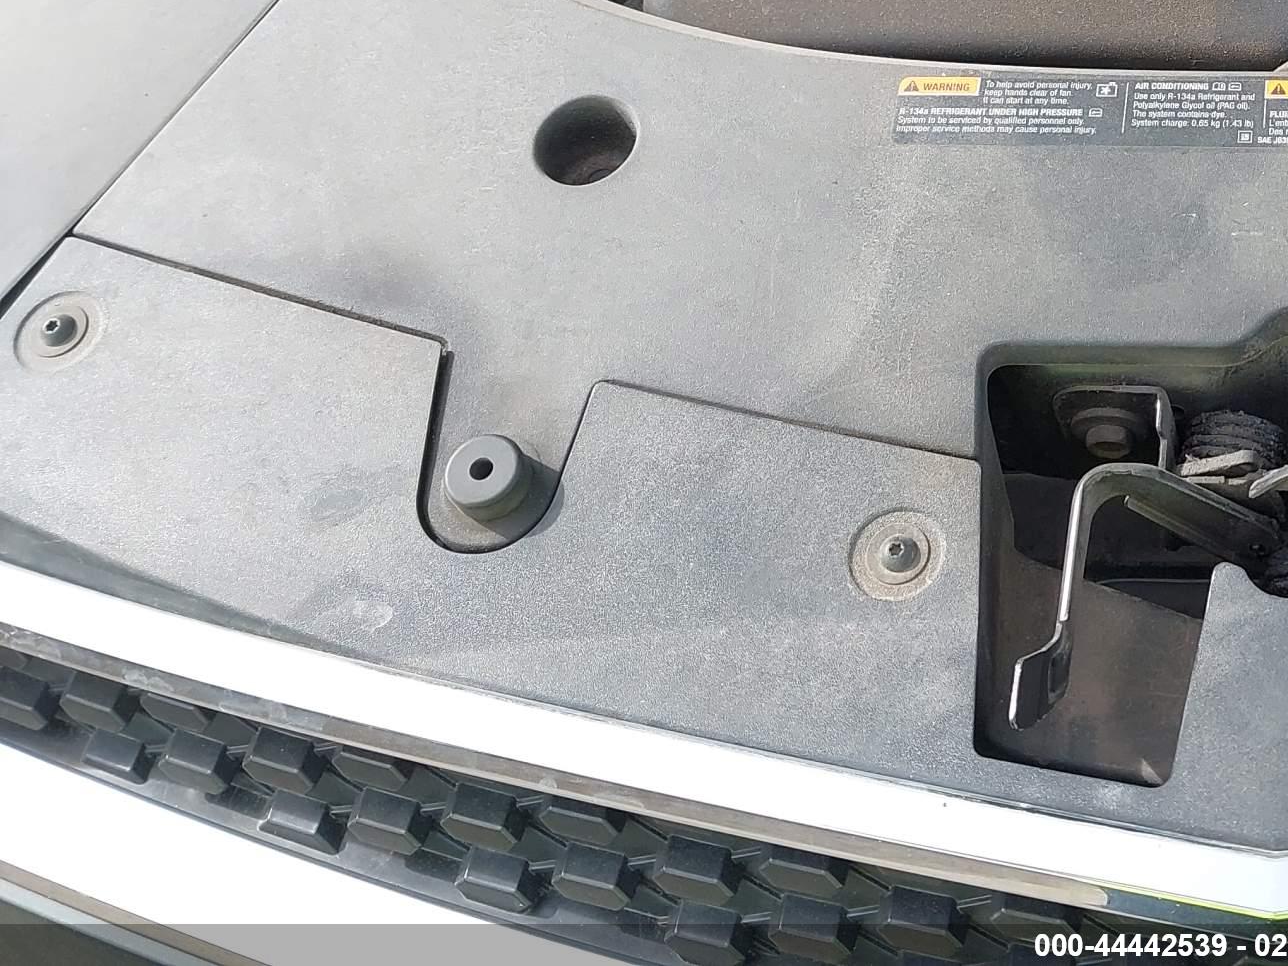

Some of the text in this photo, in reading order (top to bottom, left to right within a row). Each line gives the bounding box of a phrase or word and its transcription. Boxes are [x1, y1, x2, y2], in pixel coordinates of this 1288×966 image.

[923, 83, 970, 92] WARNING
[1150, 93, 1167, 102] only
[1197, 93, 1240, 102] Refrigerant
[1241, 93, 1255, 101] and
[1133, 101, 1179, 109] Polyalkylene
[1182, 101, 1205, 110] Glycol
[1217, 102, 1235, 110] (PAG
[989, 108, 1017, 116] UNDER
[1019, 108, 1038, 116] HIGH
[1040, 108, 1083, 116] PRESSURE
[897, 116, 926, 124] System
[983, 117, 992, 125] by
[994, 116, 1027, 126] qualified
[1028, 117, 1066, 126] personnel
[1131, 119, 1159, 127] System
[1210, 119, 1220, 128] kg
[997, 125, 1014, 134] may
[1040, 125, 1073, 134] personal
